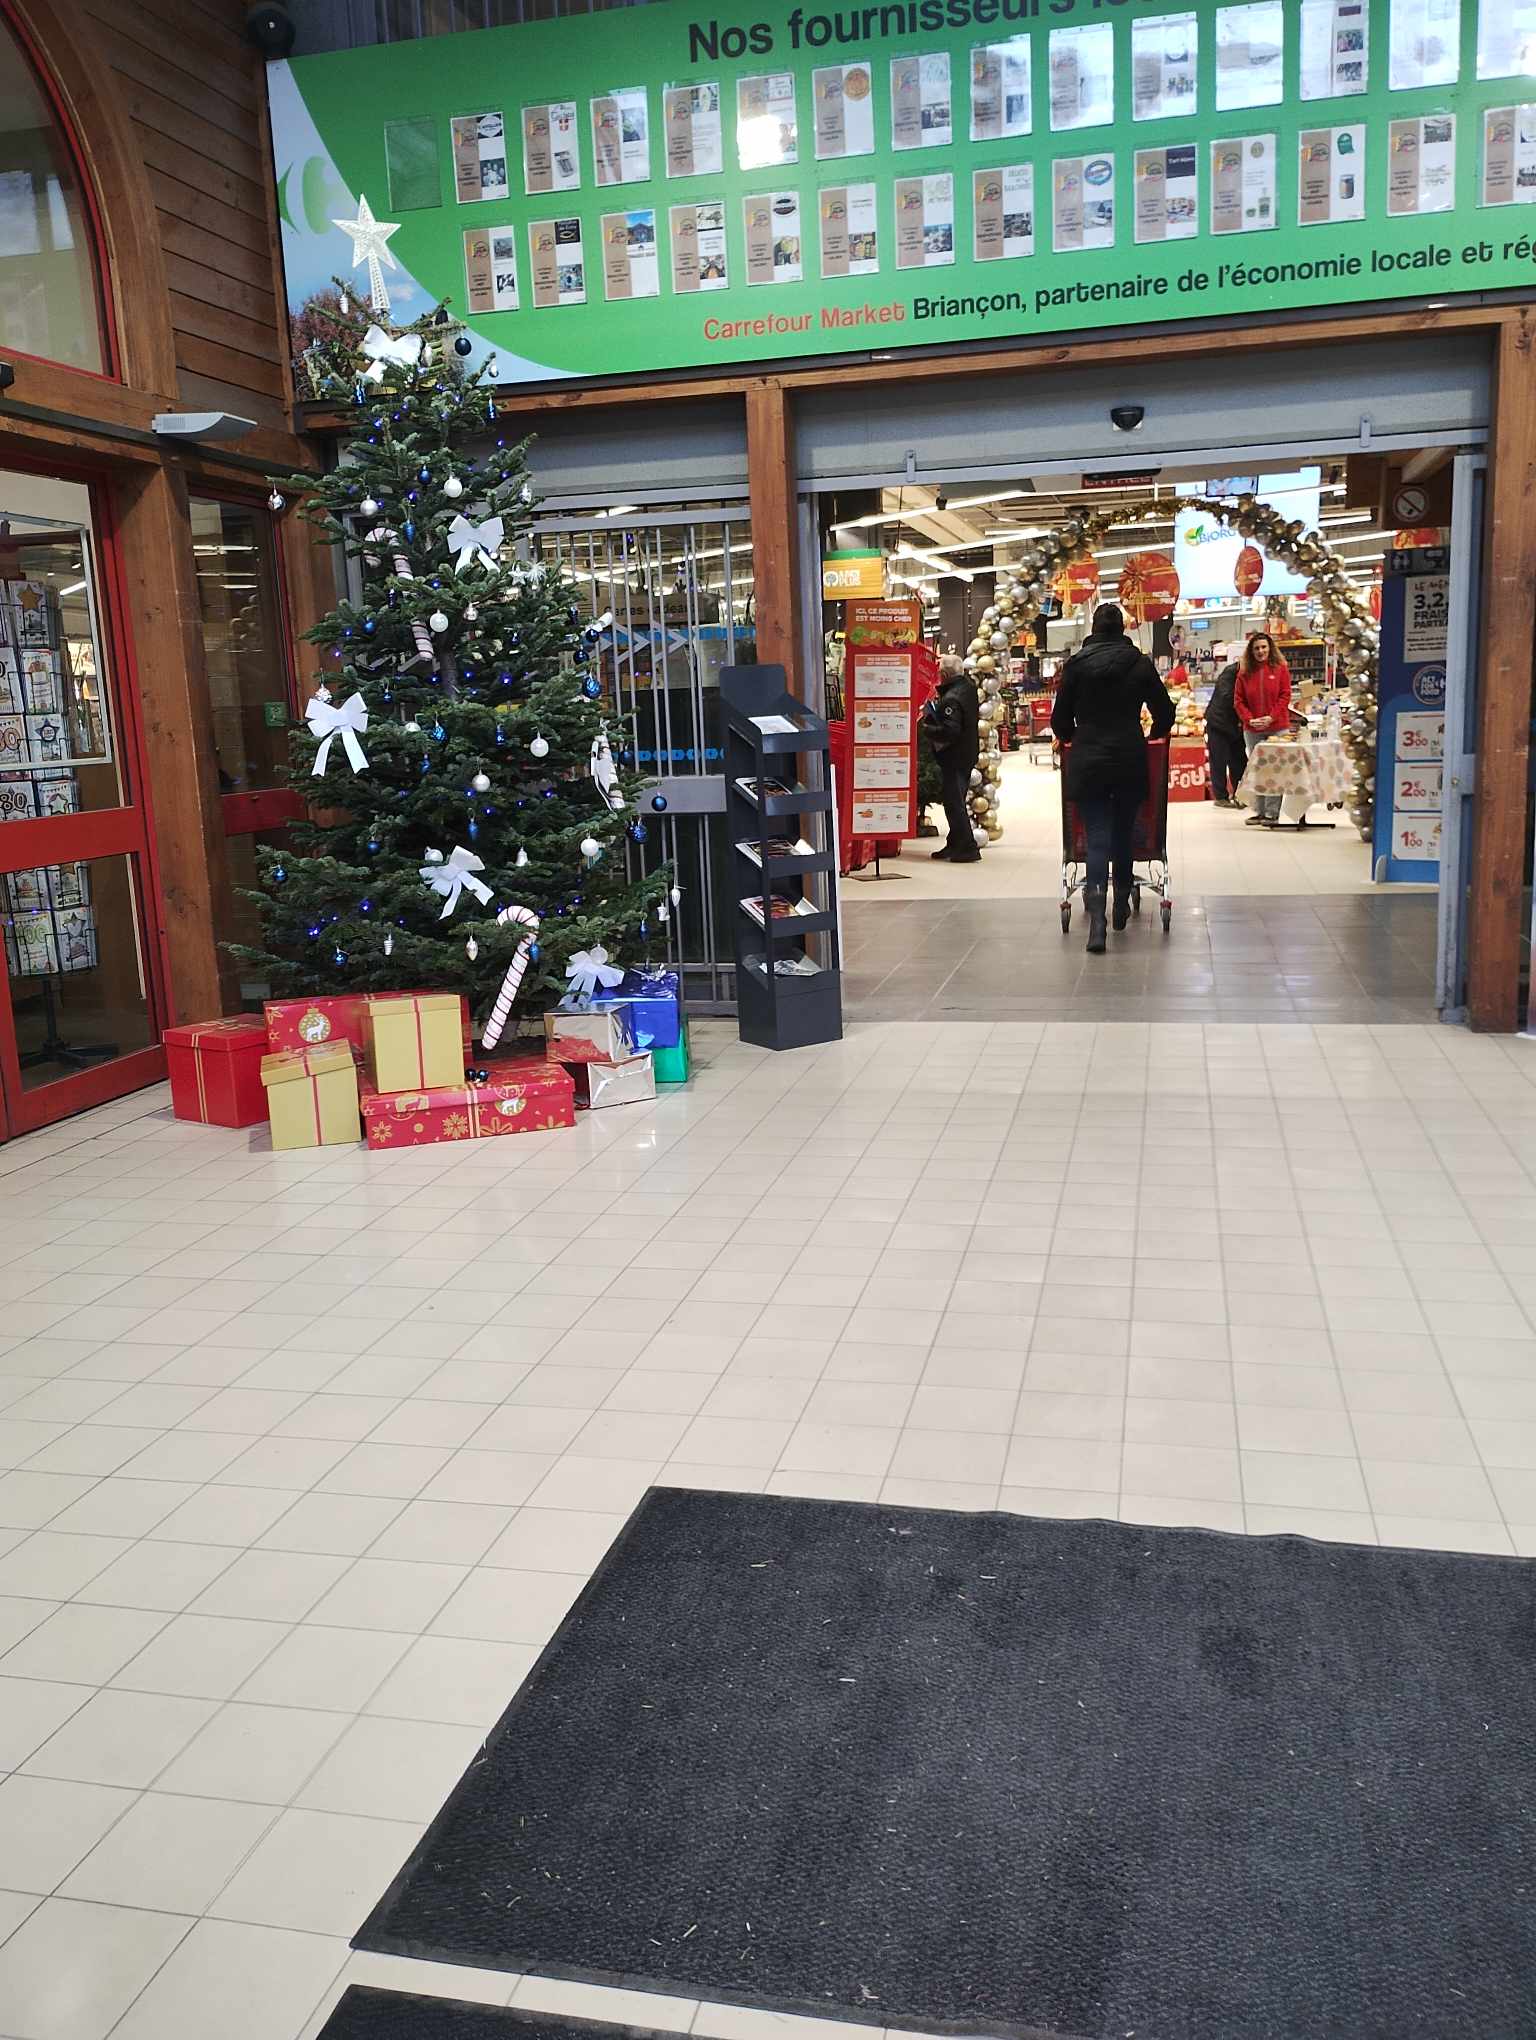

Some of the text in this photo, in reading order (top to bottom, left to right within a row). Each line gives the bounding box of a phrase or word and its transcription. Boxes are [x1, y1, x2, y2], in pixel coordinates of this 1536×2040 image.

[688, 20, 774, 63] Nos
[703, 234, 1536, 341] Carrefour Market Briançon, partenaire de l'économie locale et ré
